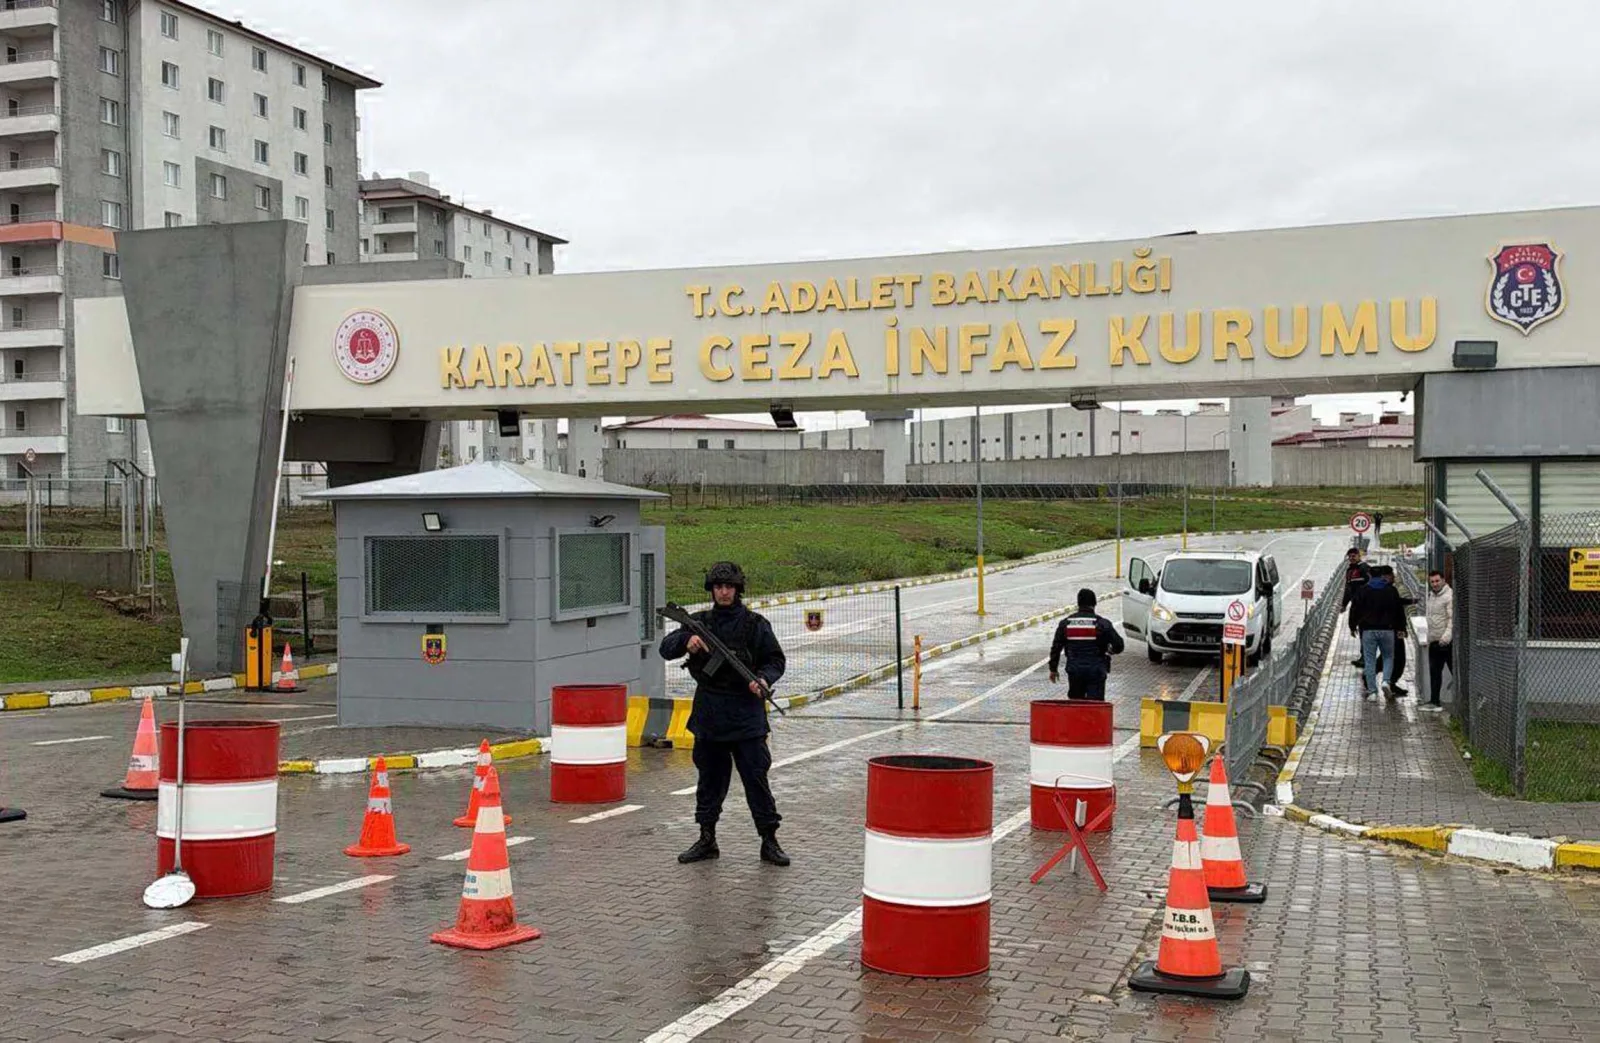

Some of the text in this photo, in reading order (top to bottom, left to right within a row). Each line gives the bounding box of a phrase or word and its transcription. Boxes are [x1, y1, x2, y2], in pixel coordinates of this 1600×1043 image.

[686, 247, 1172, 317] T.C. ADALET BAKANLIĞI
[1510, 284, 1541, 306] CTE
[440, 338, 673, 389] KARATEPE
[700, 328, 859, 382] CEZA
[885, 316, 1077, 376] İNFAZ
[1109, 297, 1437, 366] KURUMU
[1355, 518, 1366, 528] 20
[1171, 912, 1201, 924] T.B.B.
